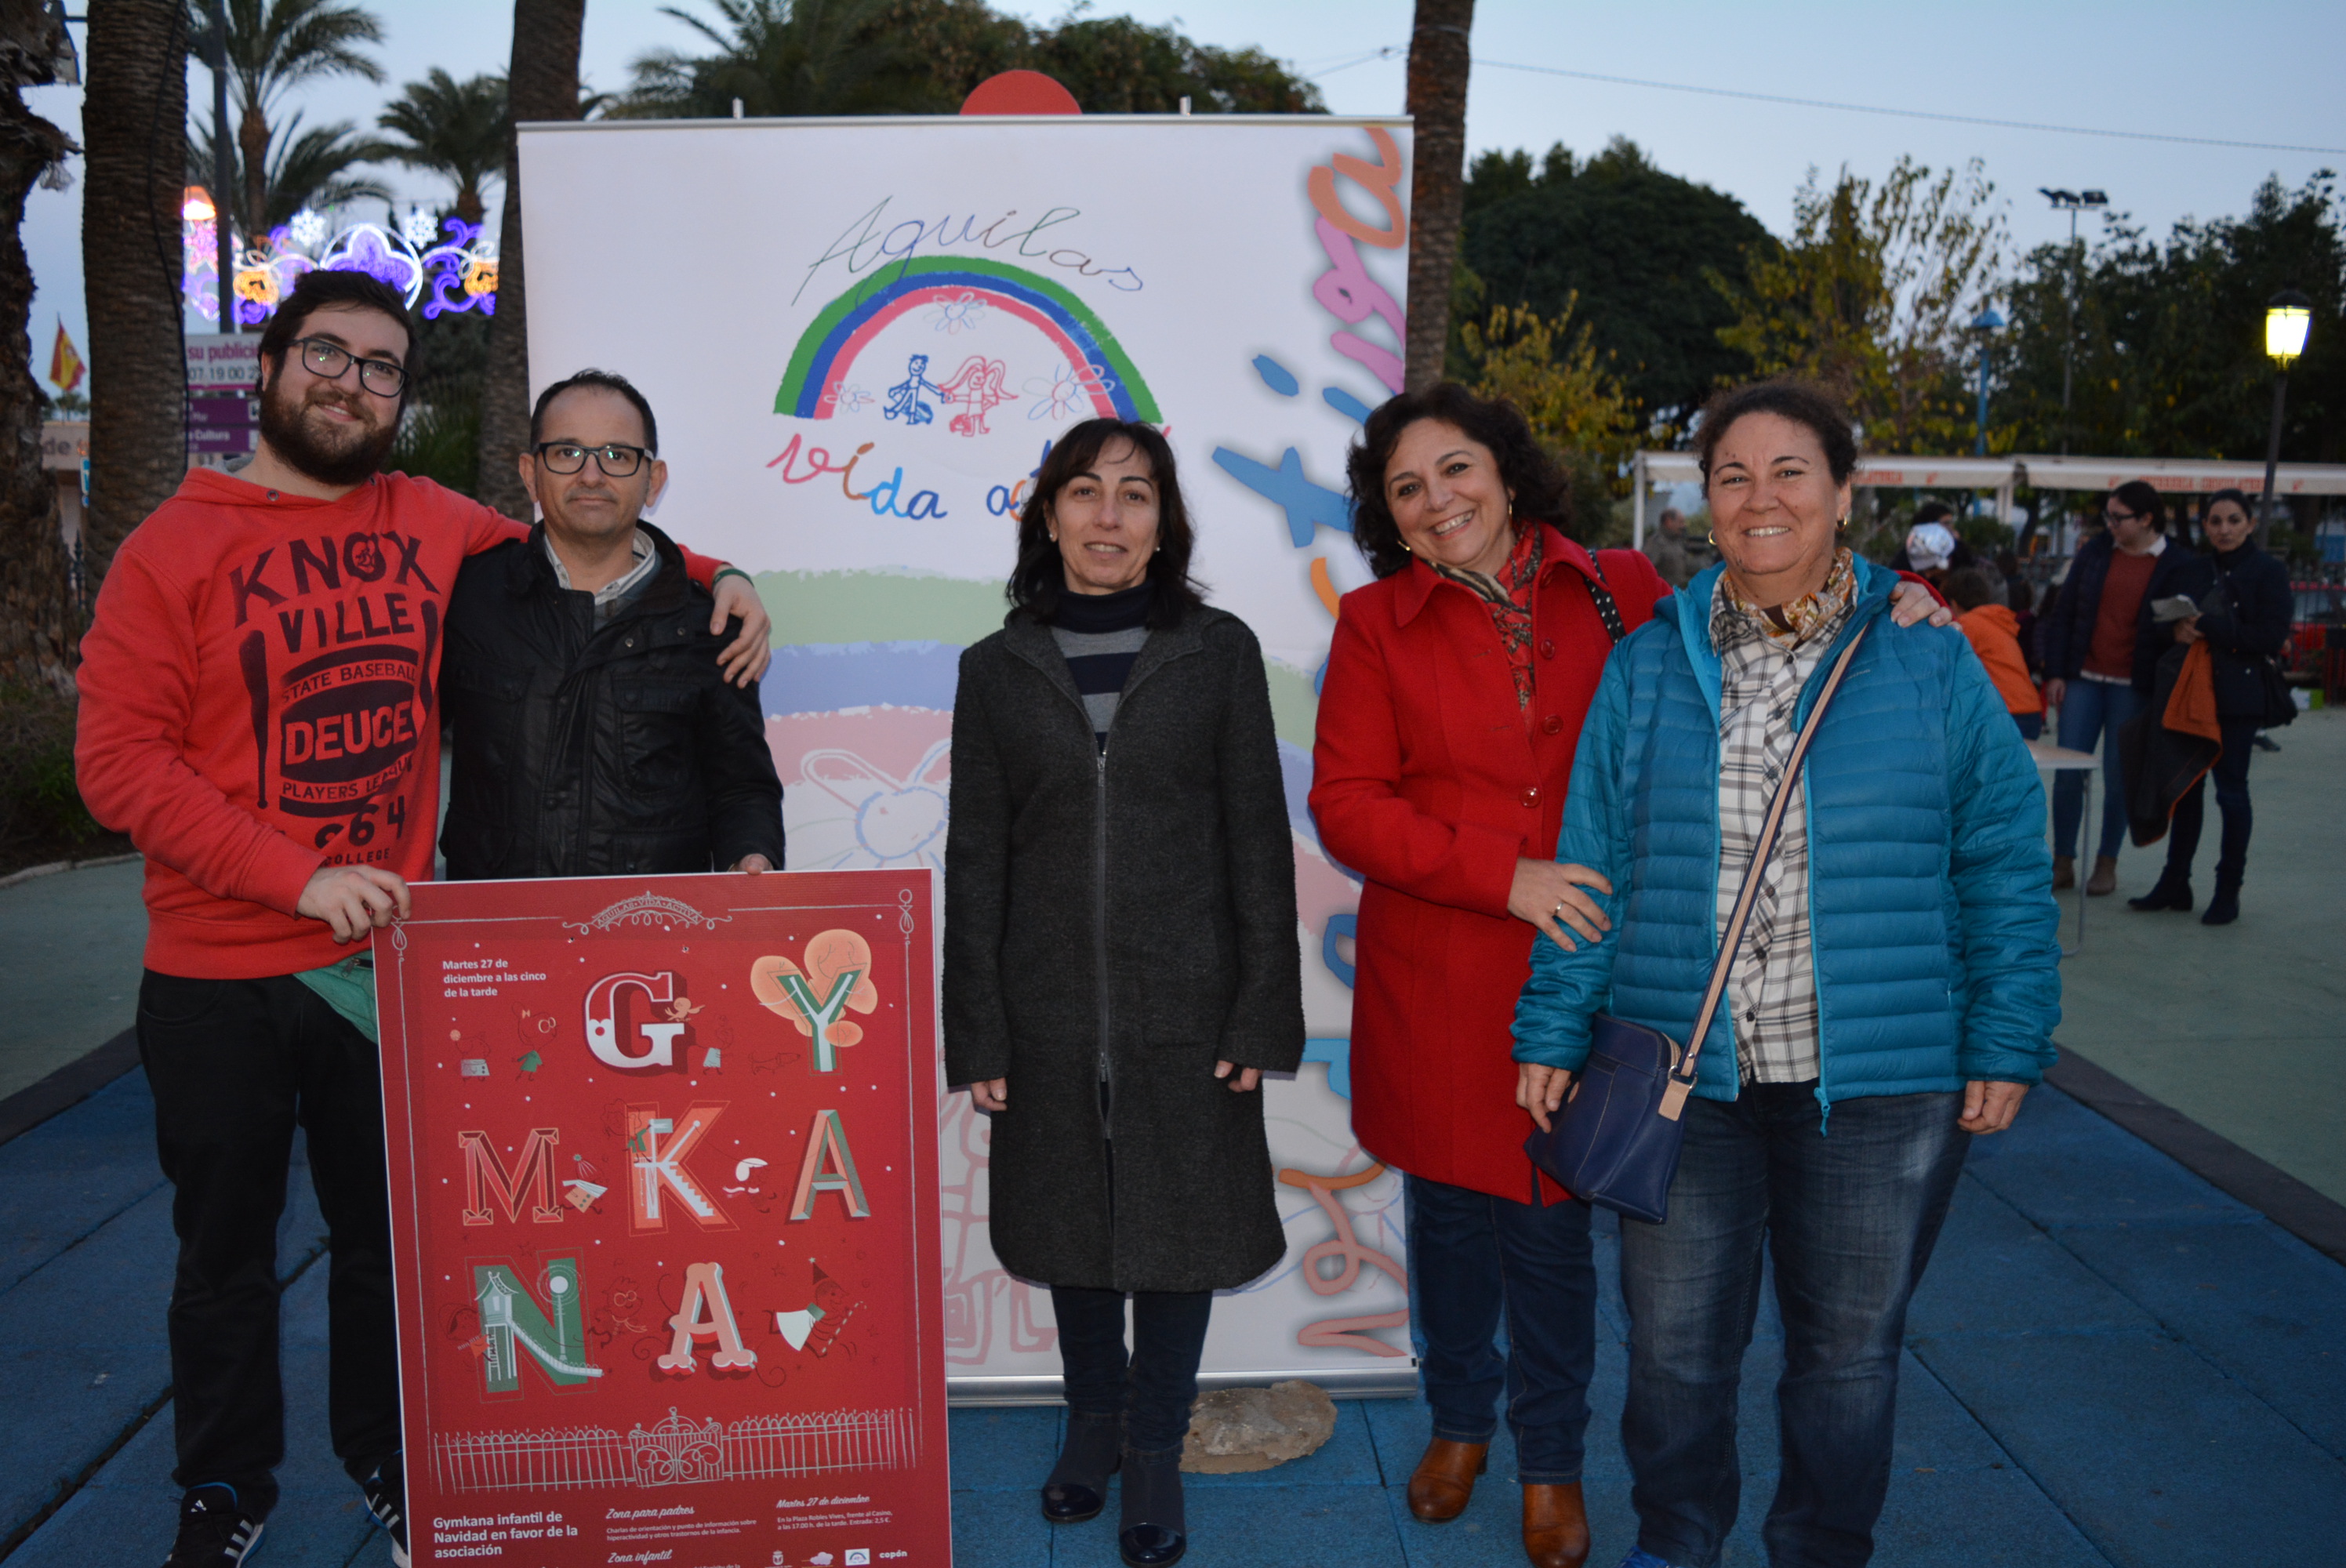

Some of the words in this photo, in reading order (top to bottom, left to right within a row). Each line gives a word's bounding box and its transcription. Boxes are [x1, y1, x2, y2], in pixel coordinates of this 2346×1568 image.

[188, 346, 204, 359] su
[210, 368, 224, 379] 19
[227, 367, 245, 379] 00
[194, 430, 230, 441] Cultura
[228, 531, 441, 629] KNOX
[278, 593, 415, 653] VILLE
[281, 672, 332, 703] STATE
[340, 663, 416, 682] BASEBALL
[285, 700, 413, 765] DEUCE
[282, 781, 358, 800] PLAYERS
[666, 902, 699, 921] ACTIVA
[442, 960, 478, 970] Martes
[481, 959, 493, 968] 27
[496, 958, 508, 968] de
[443, 973, 494, 984] diciembre
[504, 972, 518, 982] las
[520, 971, 547, 982] cinco
[444, 988, 457, 998] de
[459, 987, 469, 997] la
[470, 986, 498, 996] tarde
[775, 1498, 804, 1508] Martes
[806, 1497, 818, 1507] 27
[819, 1497, 830, 1505] de
[831, 1494, 870, 1504] diciembre
[605, 1508, 631, 1519] Zona
[631, 1508, 658, 1520] para
[659, 1504, 695, 1519] padres
[433, 1515, 494, 1530] Gymkana
[497, 1512, 543, 1526] infantil
[547, 1511, 562, 1523] de
[434, 1530, 487, 1543] Navidad
[491, 1531, 507, 1541] en
[510, 1527, 543, 1539] favor
[547, 1526, 563, 1537] de
[566, 1525, 578, 1537] la
[434, 1544, 502, 1559] asociación
[608, 1552, 633, 1563] Zona
[635, 1549, 673, 1565] infantil
[879, 1549, 908, 1559] copón
